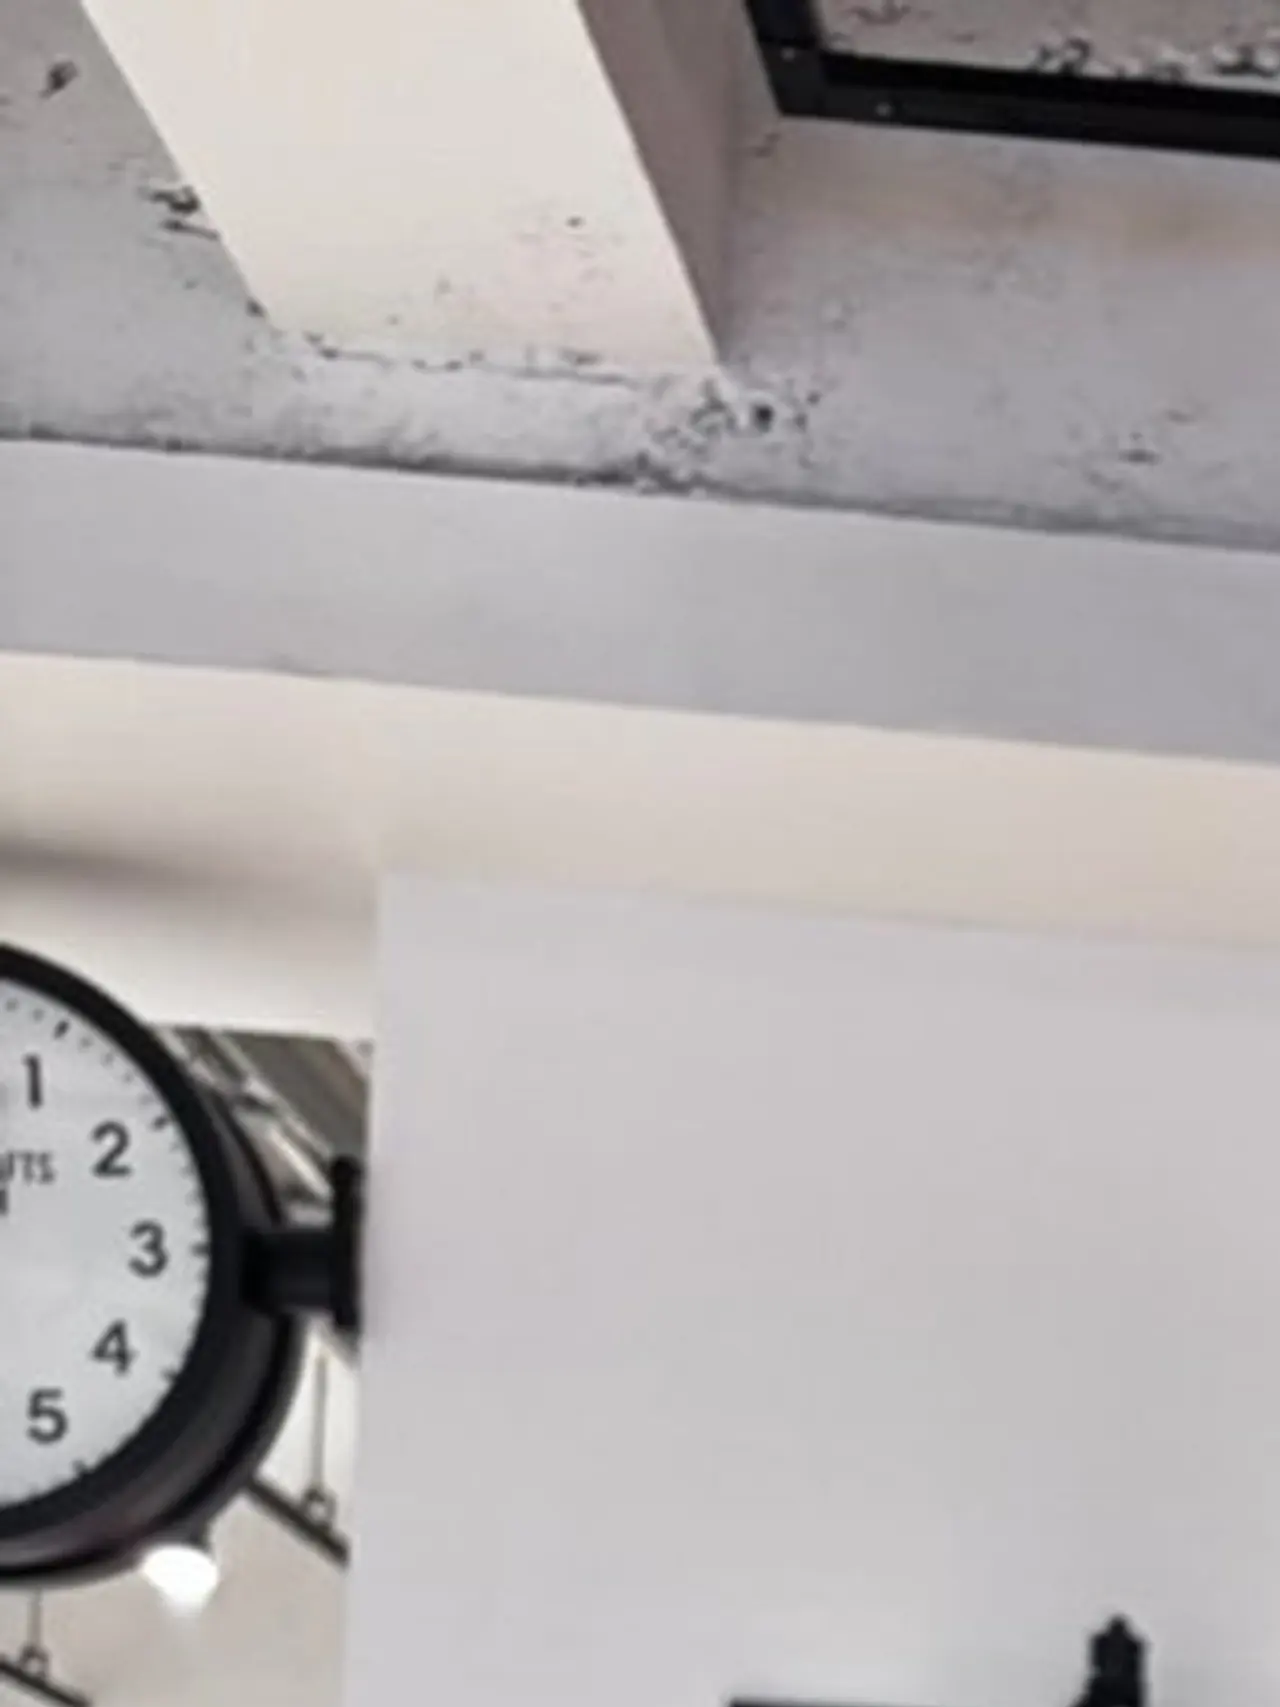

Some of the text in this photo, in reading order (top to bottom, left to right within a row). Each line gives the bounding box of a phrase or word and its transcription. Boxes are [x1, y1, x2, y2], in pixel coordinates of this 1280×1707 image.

[23, 1054, 44, 1109] 1
[91, 1120, 132, 1179] 2
[128, 1219, 170, 1279] 3
[91, 1319, 134, 1375] 4
[26, 1387, 69, 1446] 5
